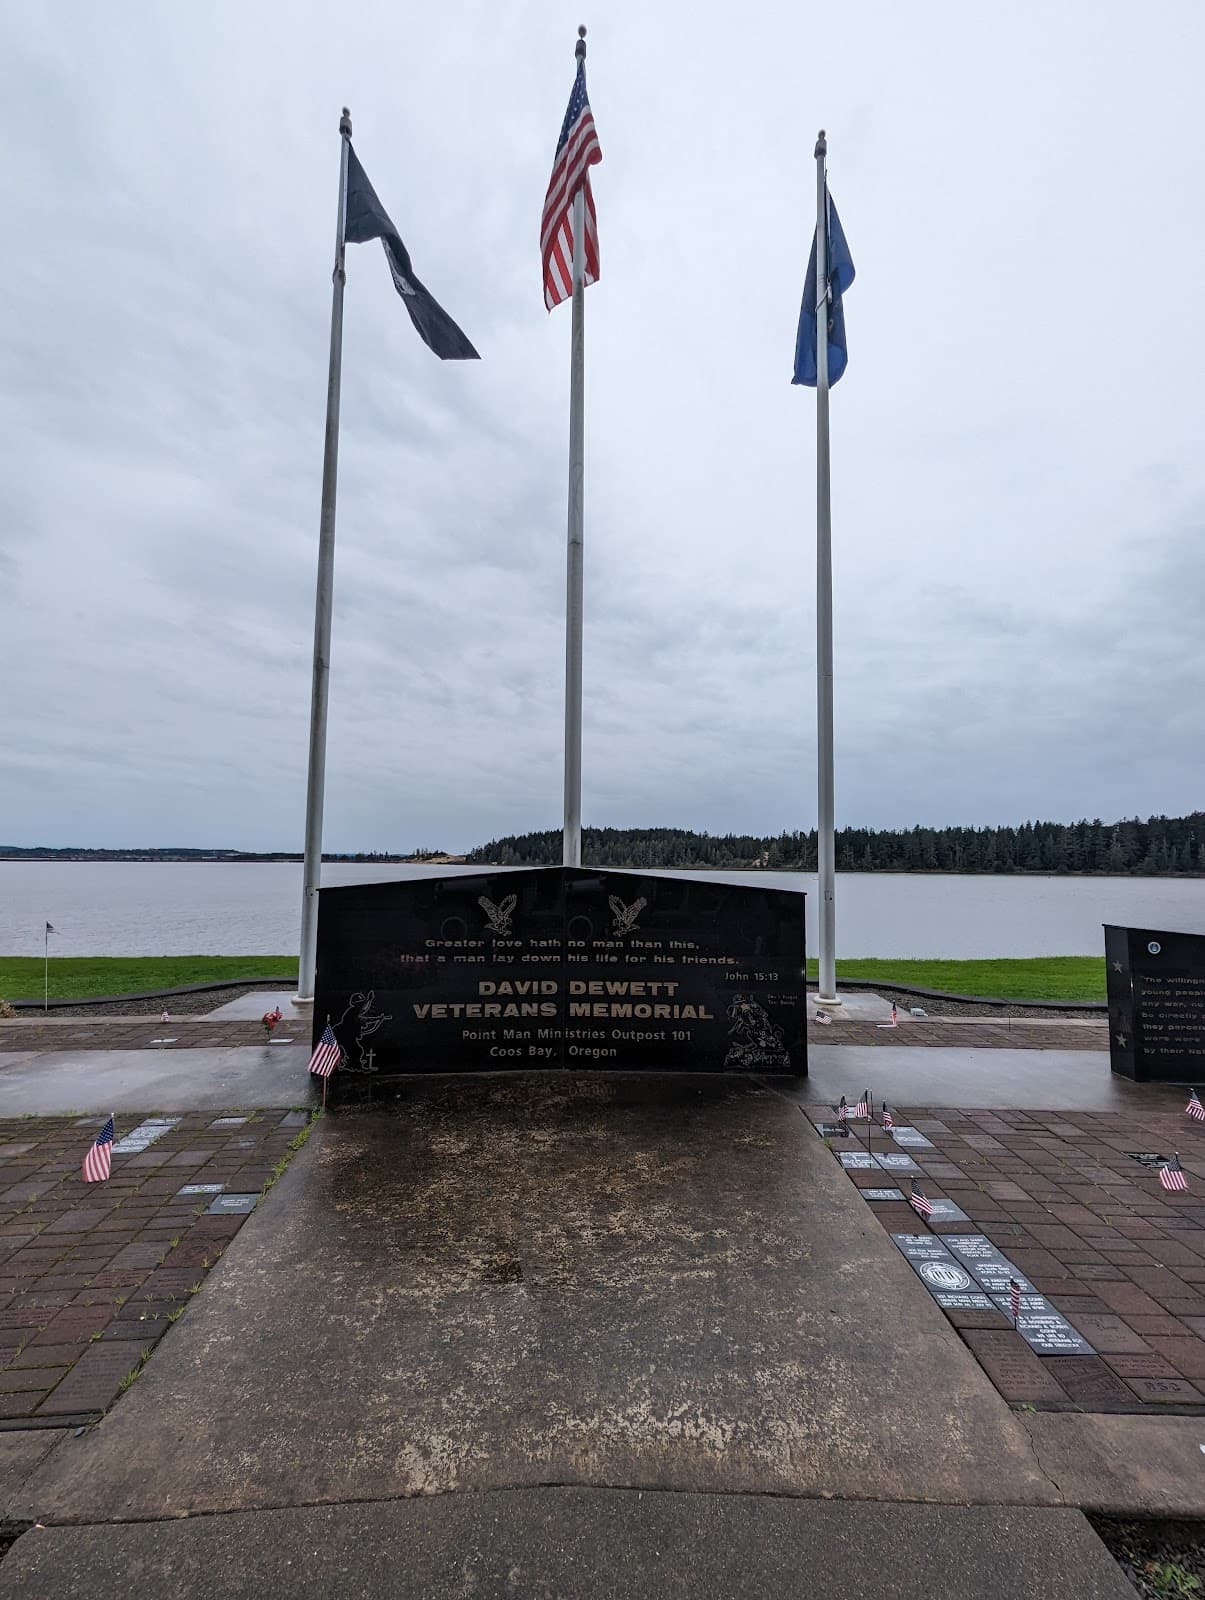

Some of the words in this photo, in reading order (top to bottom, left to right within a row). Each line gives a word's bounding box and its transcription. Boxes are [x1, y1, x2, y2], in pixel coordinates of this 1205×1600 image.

[425, 939, 485, 948] Greater
[492, 938, 523, 947] love
[530, 938, 561, 947] hath
[631, 940, 662, 948] than
[400, 954, 430, 963] that
[492, 954, 515, 964] lay
[521, 954, 561, 962] down
[568, 954, 589, 962] his
[596, 954, 618, 962] life
[625, 954, 646, 962] for
[654, 955, 676, 963] his
[682, 955, 739, 965] friends.
[725, 972, 749, 980] John
[754, 972, 779, 981] 15:13
[479, 980, 558, 996] DAVID
[569, 980, 679, 996] DEWETT
[413, 1002, 558, 1019] VETERANS
[569, 1002, 714, 1019] MEMORIAL
[463, 1030, 497, 1040] Point
[503, 1029, 531, 1039] Man
[538, 1028, 606, 1039] Ministries
[612, 1029, 666, 1042] Outpost
[672, 1030, 692, 1041] 101
[490, 1046, 522, 1057] Coos
[528, 1046, 557, 1058] Bay,
[568, 1046, 617, 1059] Oregon
